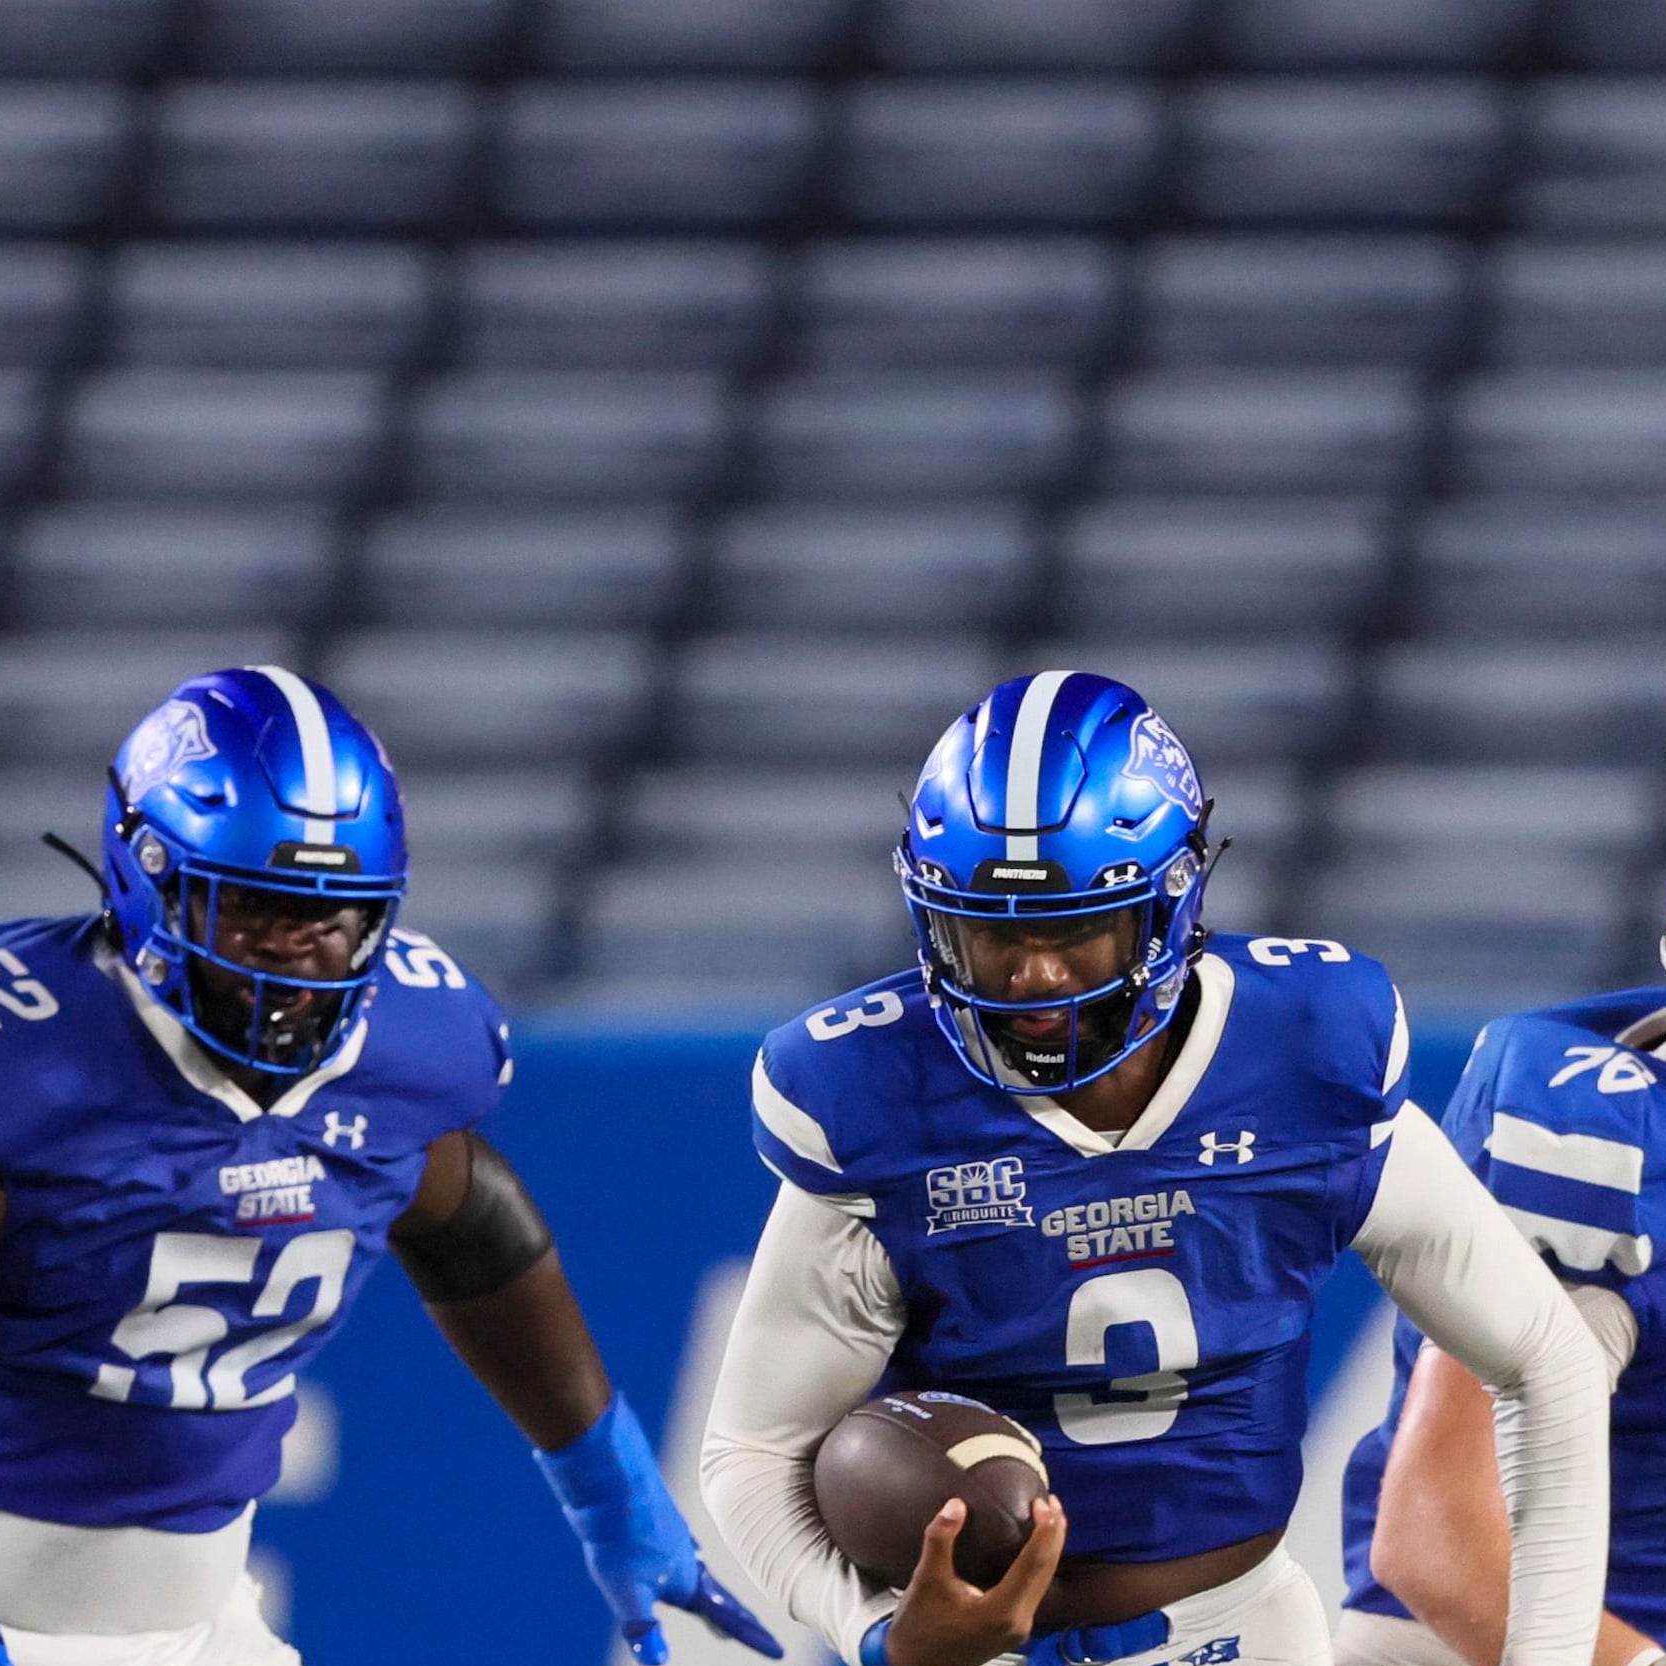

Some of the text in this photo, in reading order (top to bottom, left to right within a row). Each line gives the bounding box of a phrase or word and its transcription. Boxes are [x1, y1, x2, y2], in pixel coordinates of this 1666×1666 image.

[1247, 936, 1351, 968] 3
[805, 990, 904, 1042] 3
[1025, 1051, 1065, 1064] Riddell
[1547, 1045, 1658, 1094] 76
[219, 1154, 327, 1195] GEORGIA
[926, 1156, 1026, 1211] SBC
[236, 1184, 315, 1219] STATE
[942, 1202, 1017, 1224] GRADUATE
[1041, 1190, 1196, 1237] GEORGIA
[1067, 1220, 1175, 1260] STATE
[89, 1228, 356, 1412] 52
[1052, 1268, 1199, 1445] 3
